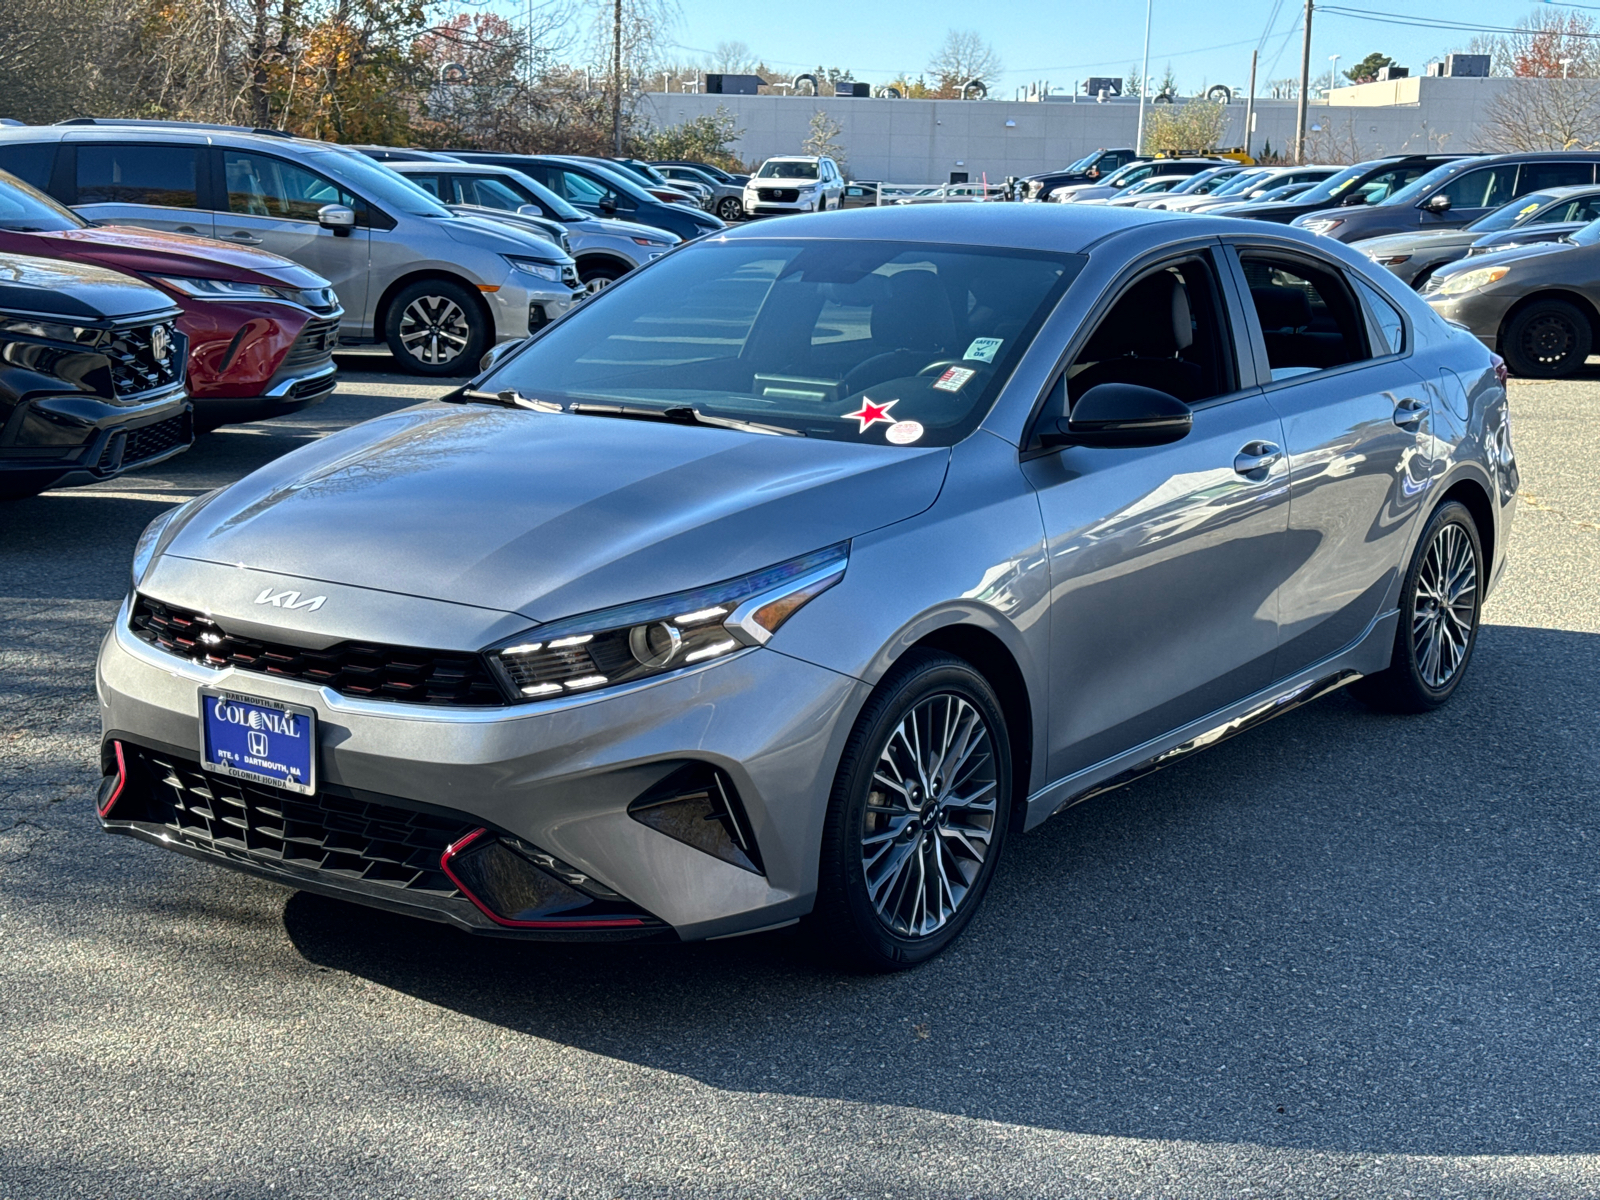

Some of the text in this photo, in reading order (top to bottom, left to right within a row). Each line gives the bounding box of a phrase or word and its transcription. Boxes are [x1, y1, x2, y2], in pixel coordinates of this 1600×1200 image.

[254, 587, 327, 612] KIA
[274, 702, 285, 710] MA
[214, 703, 300, 738] COLONIAL
[218, 750, 234, 760] RTE.
[290, 766, 301, 776] MA
[228, 768, 287, 789] COLONIAL HONDA
